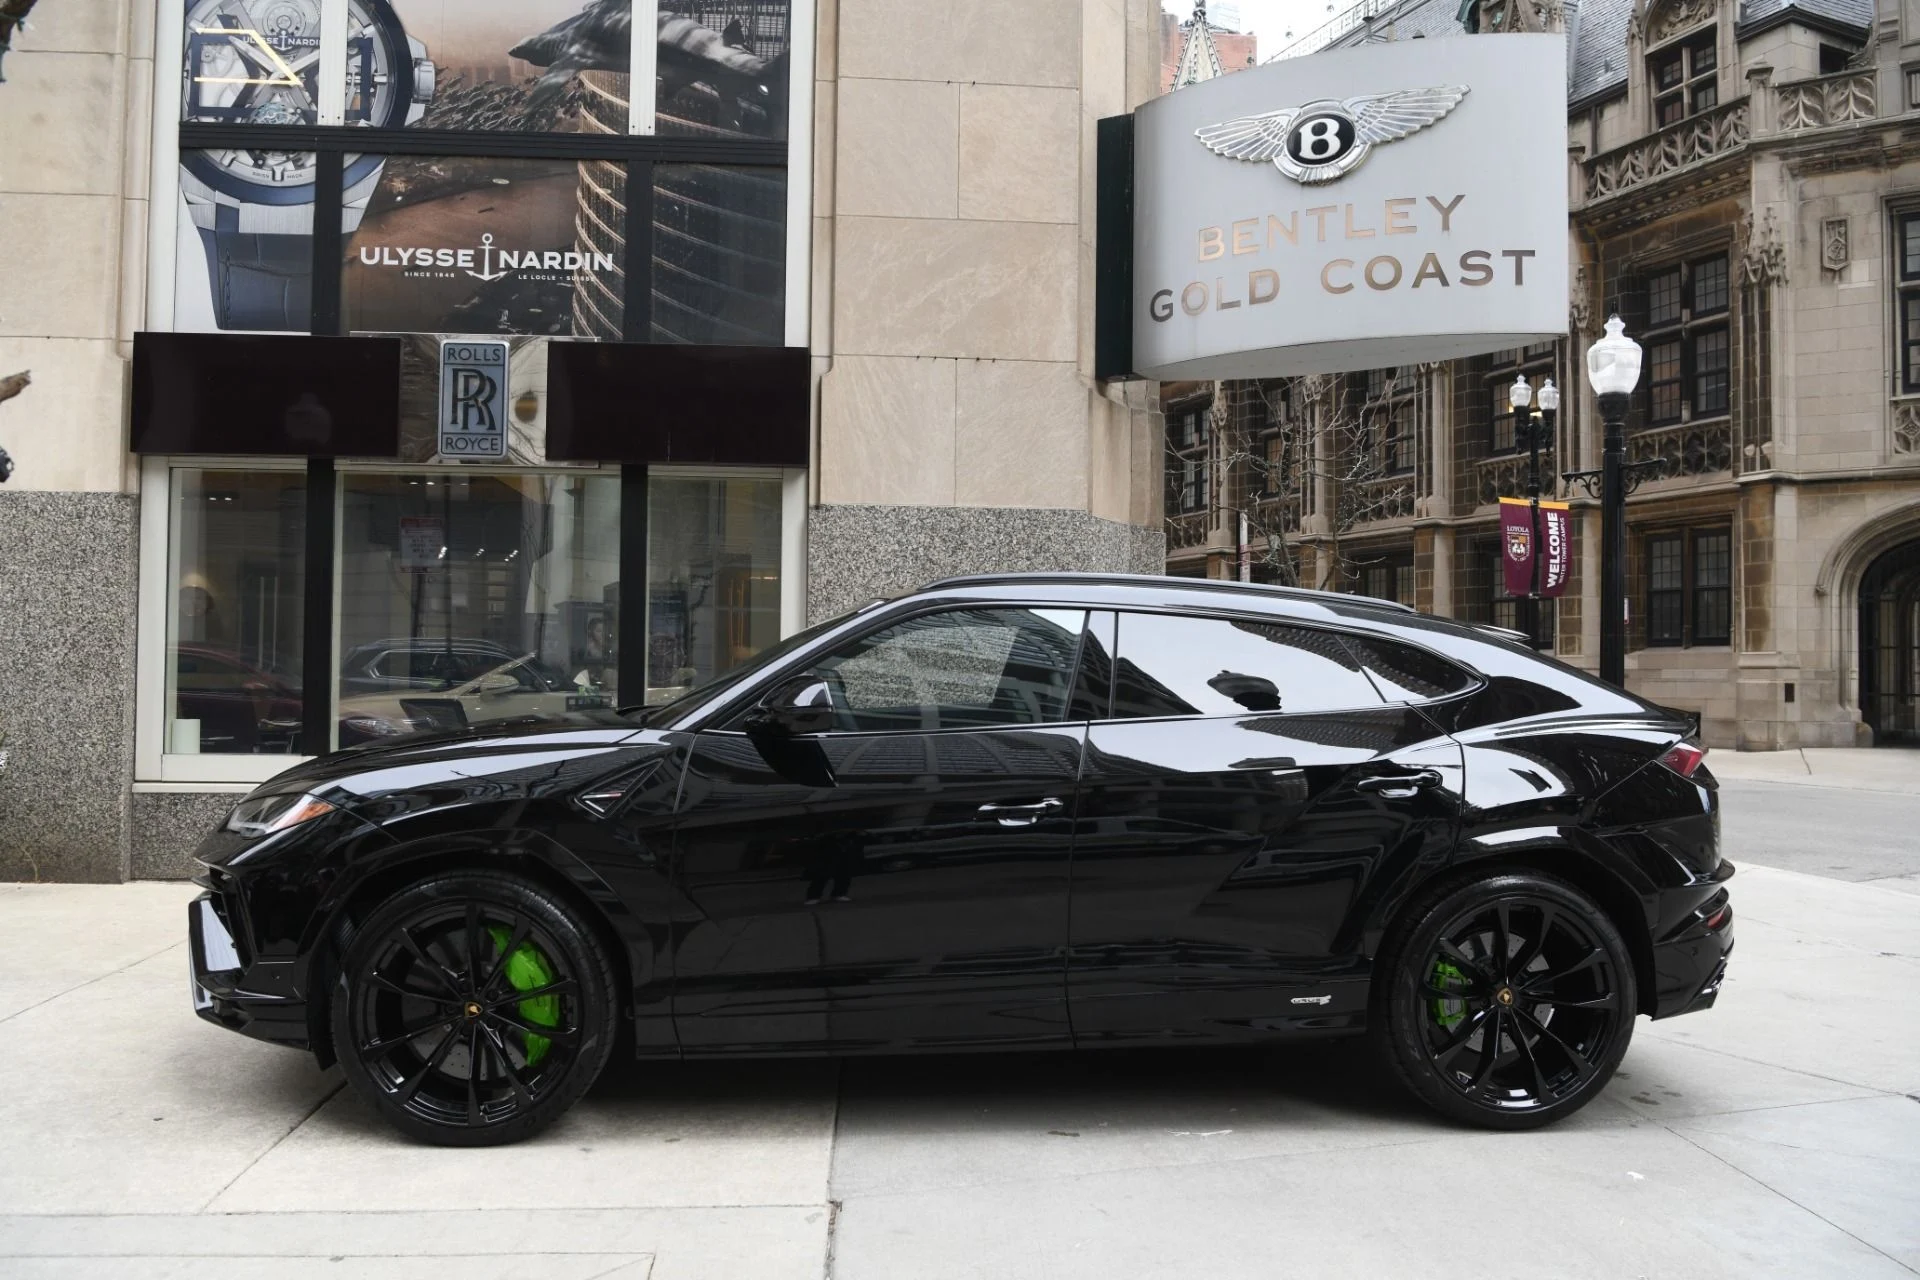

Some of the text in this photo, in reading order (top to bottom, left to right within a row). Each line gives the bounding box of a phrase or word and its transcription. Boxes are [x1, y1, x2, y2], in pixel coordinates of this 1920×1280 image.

[243, 36, 320, 46] ULSE NARDI
[1299, 118, 1341, 160] B
[1198, 194, 1466, 263] BENTLEY
[360, 247, 613, 271] ULYSSE NARDIN
[1149, 248, 1536, 323] GOLD COAST
[447, 347, 501, 361] ROLLS
[445, 437, 499, 451] ROYCE
[1506, 524, 1529, 533] LOYOLA
[1547, 512, 1560, 588] WELCOME
